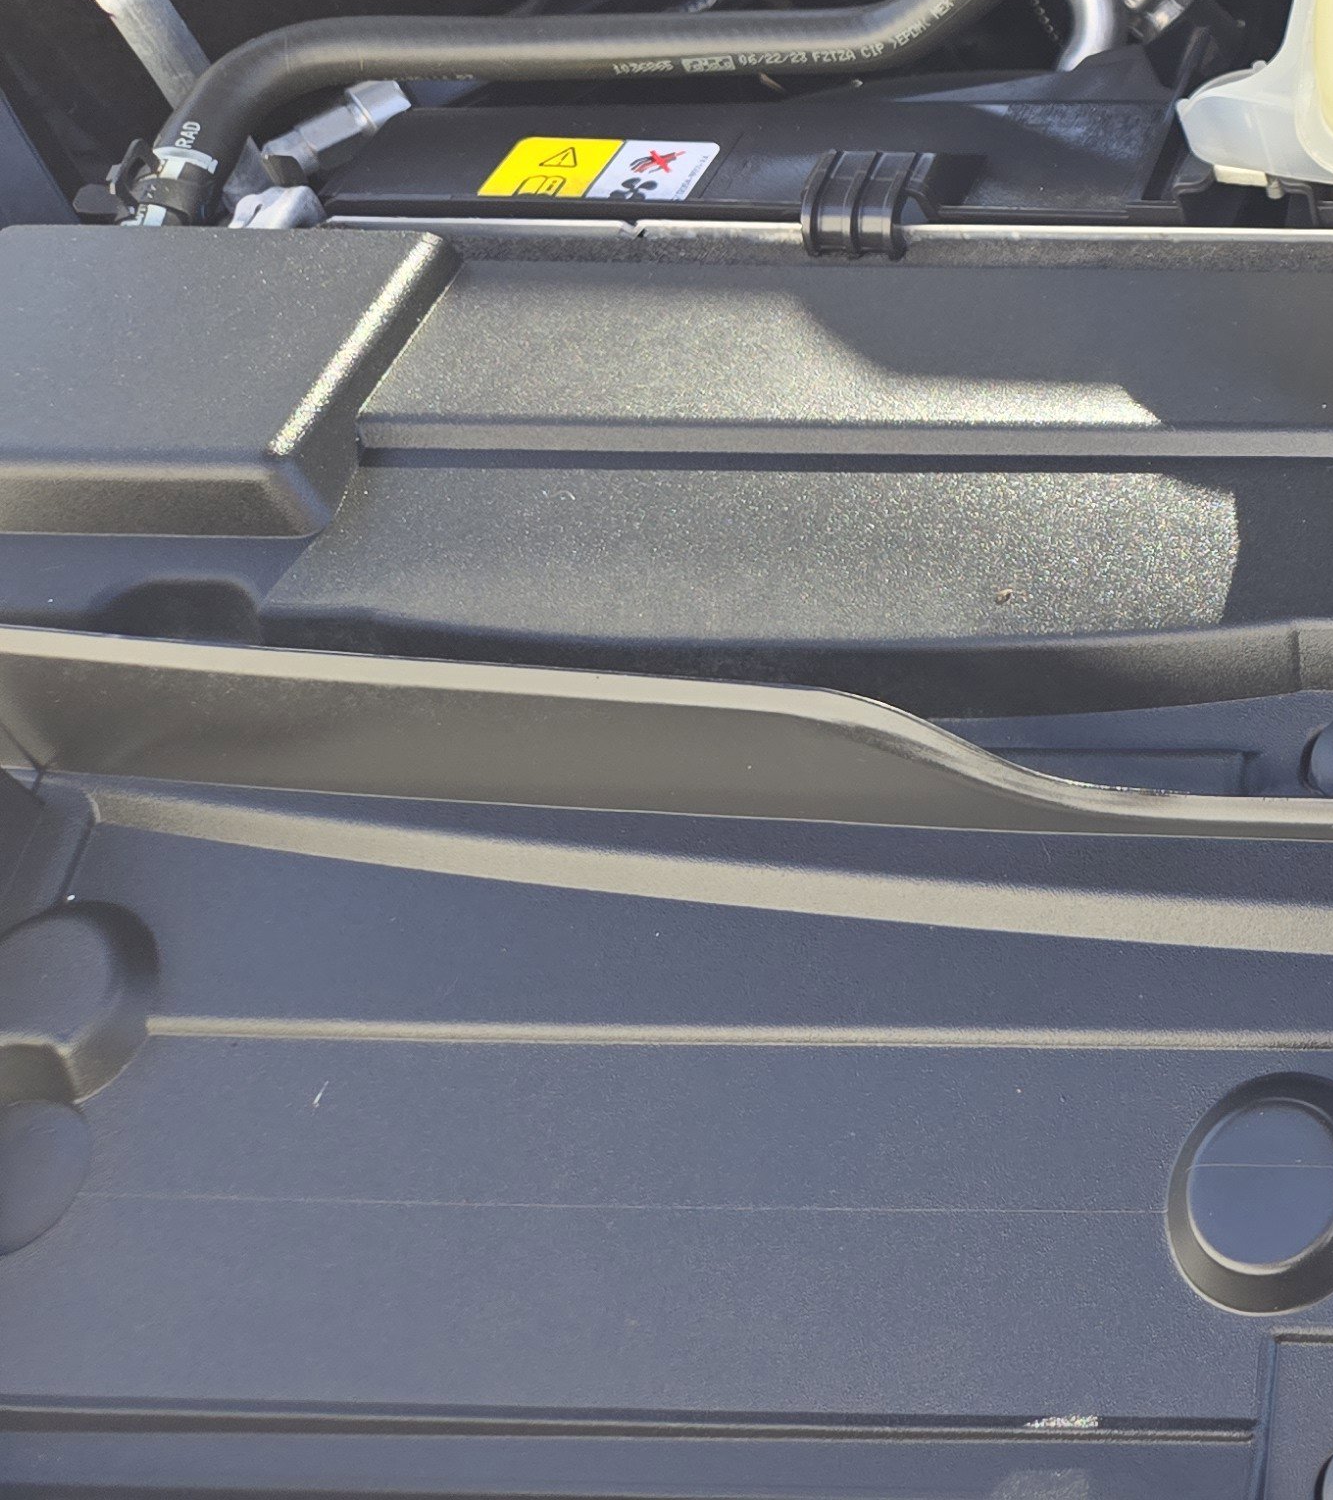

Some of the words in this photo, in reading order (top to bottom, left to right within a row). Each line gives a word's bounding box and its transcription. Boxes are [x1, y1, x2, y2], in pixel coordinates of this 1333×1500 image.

[738, 51, 808, 67] 06/22/23
[860, 44, 884, 59] CIP
[175, 121, 201, 149] RAD
